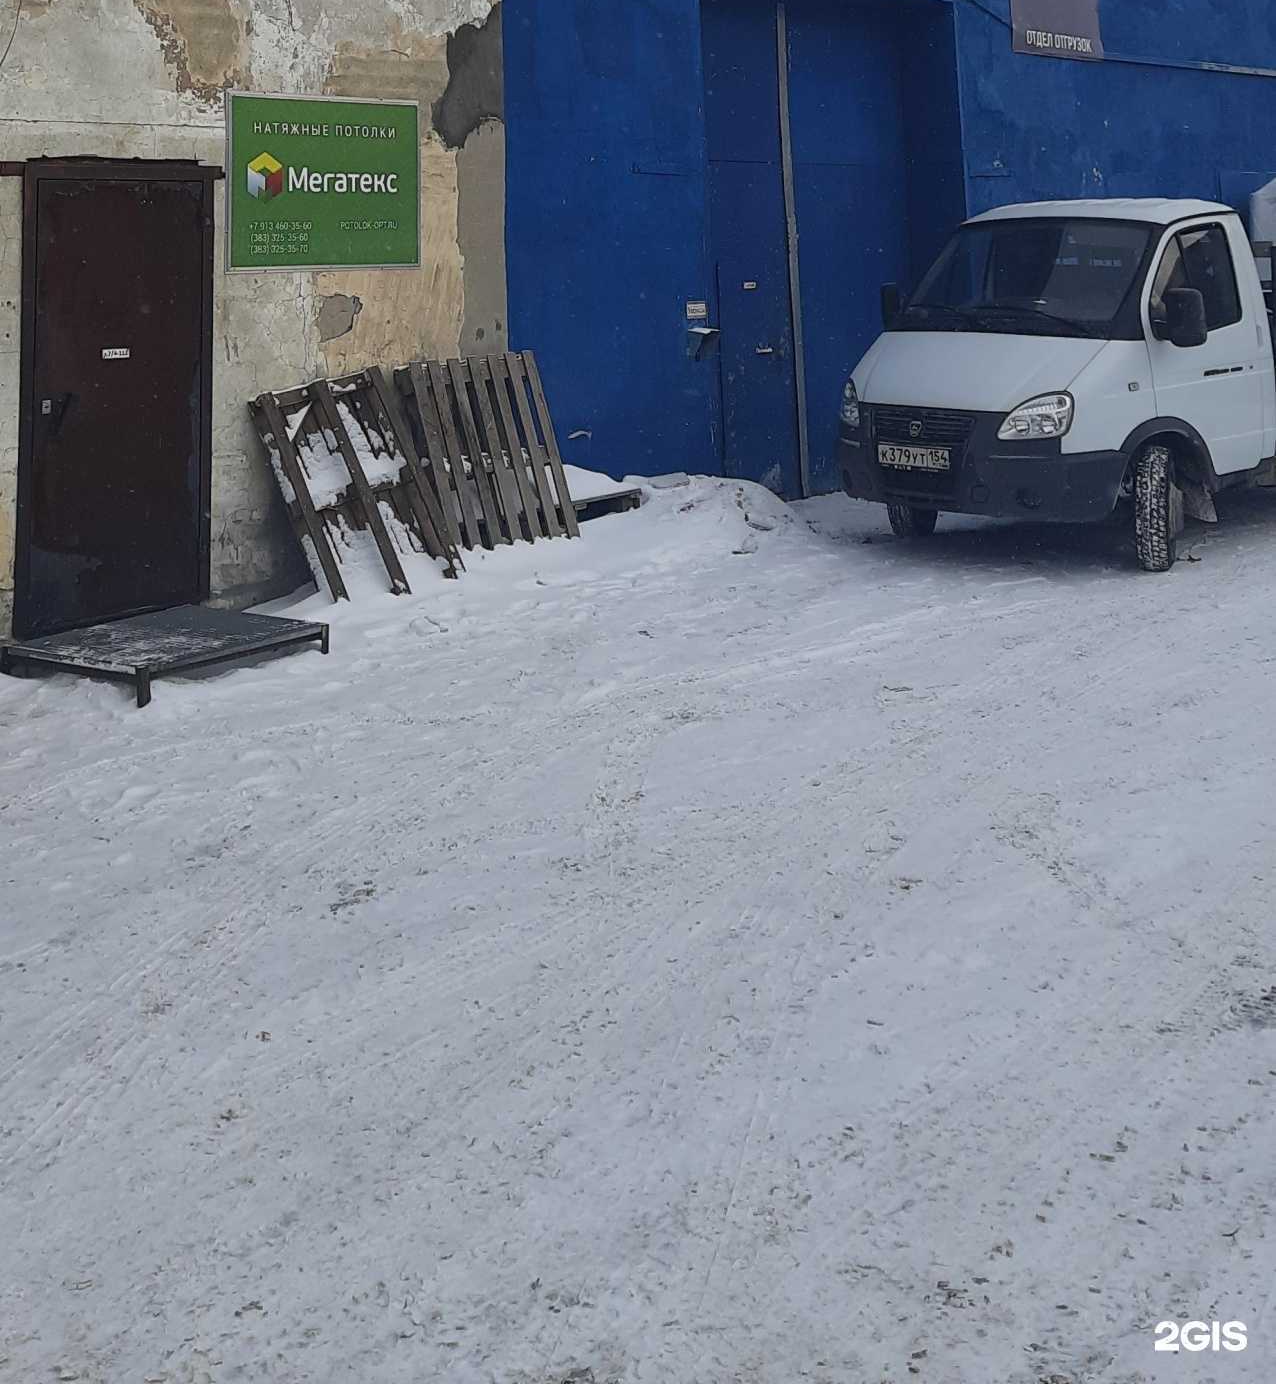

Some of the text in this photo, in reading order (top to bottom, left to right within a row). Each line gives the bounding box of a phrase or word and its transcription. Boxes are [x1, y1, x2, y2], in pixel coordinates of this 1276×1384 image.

[1026, 30, 1092, 53] ОТДЕЛ ОТГРУЗОК
[253, 122, 396, 138] НАТЯЖНЫЕ ПОТОЛКИ
[288, 166, 398, 193] Мегатекс
[928, 450, 947, 463] 154
